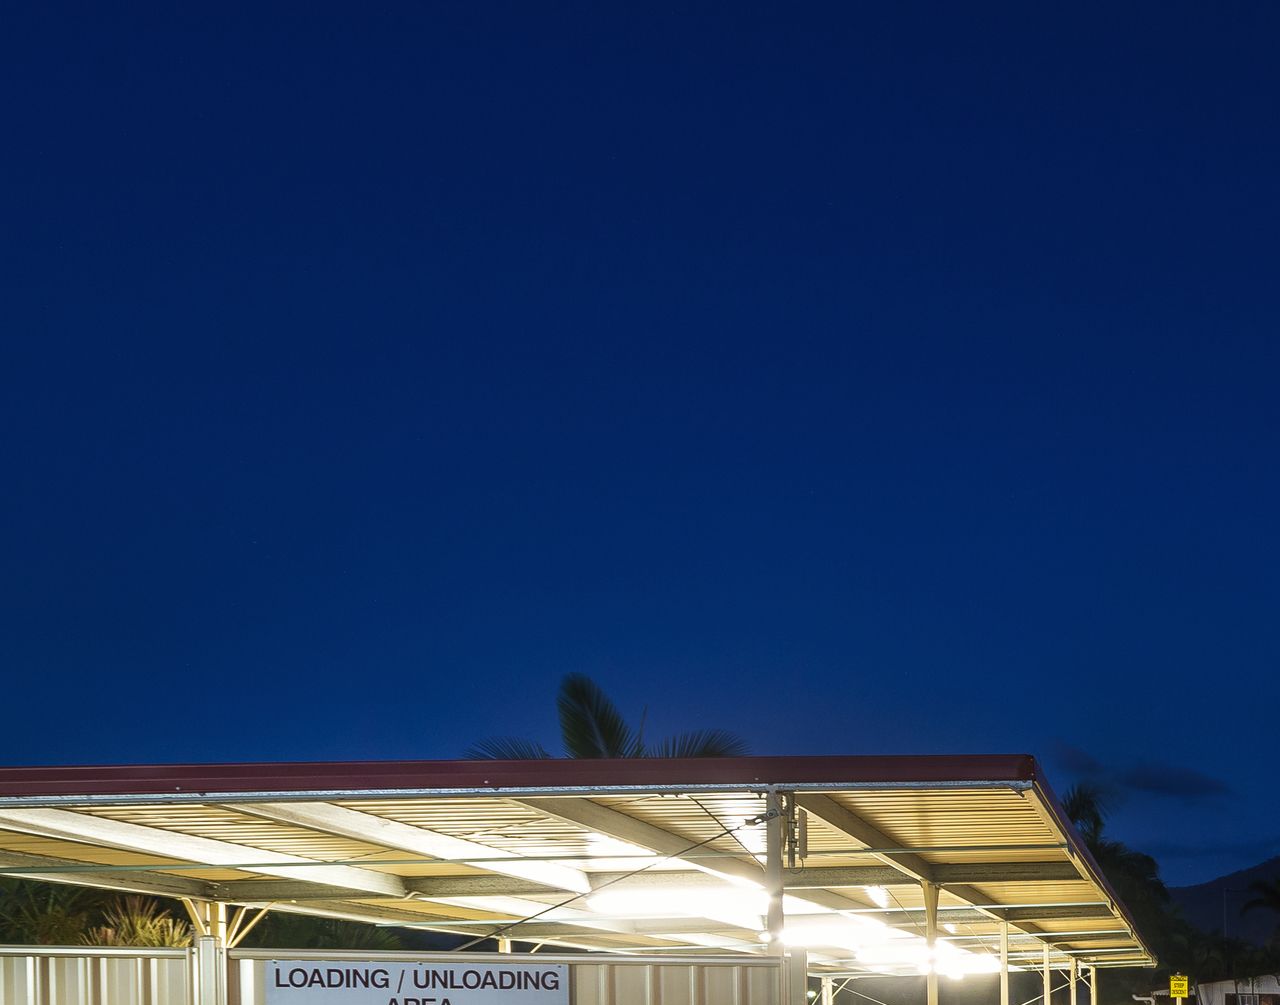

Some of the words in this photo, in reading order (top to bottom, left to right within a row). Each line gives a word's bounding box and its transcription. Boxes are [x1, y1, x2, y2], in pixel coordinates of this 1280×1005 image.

[275, 968, 389, 988] LOADING
[397, 970, 405, 993] /
[413, 970, 559, 990] UNLOADING
